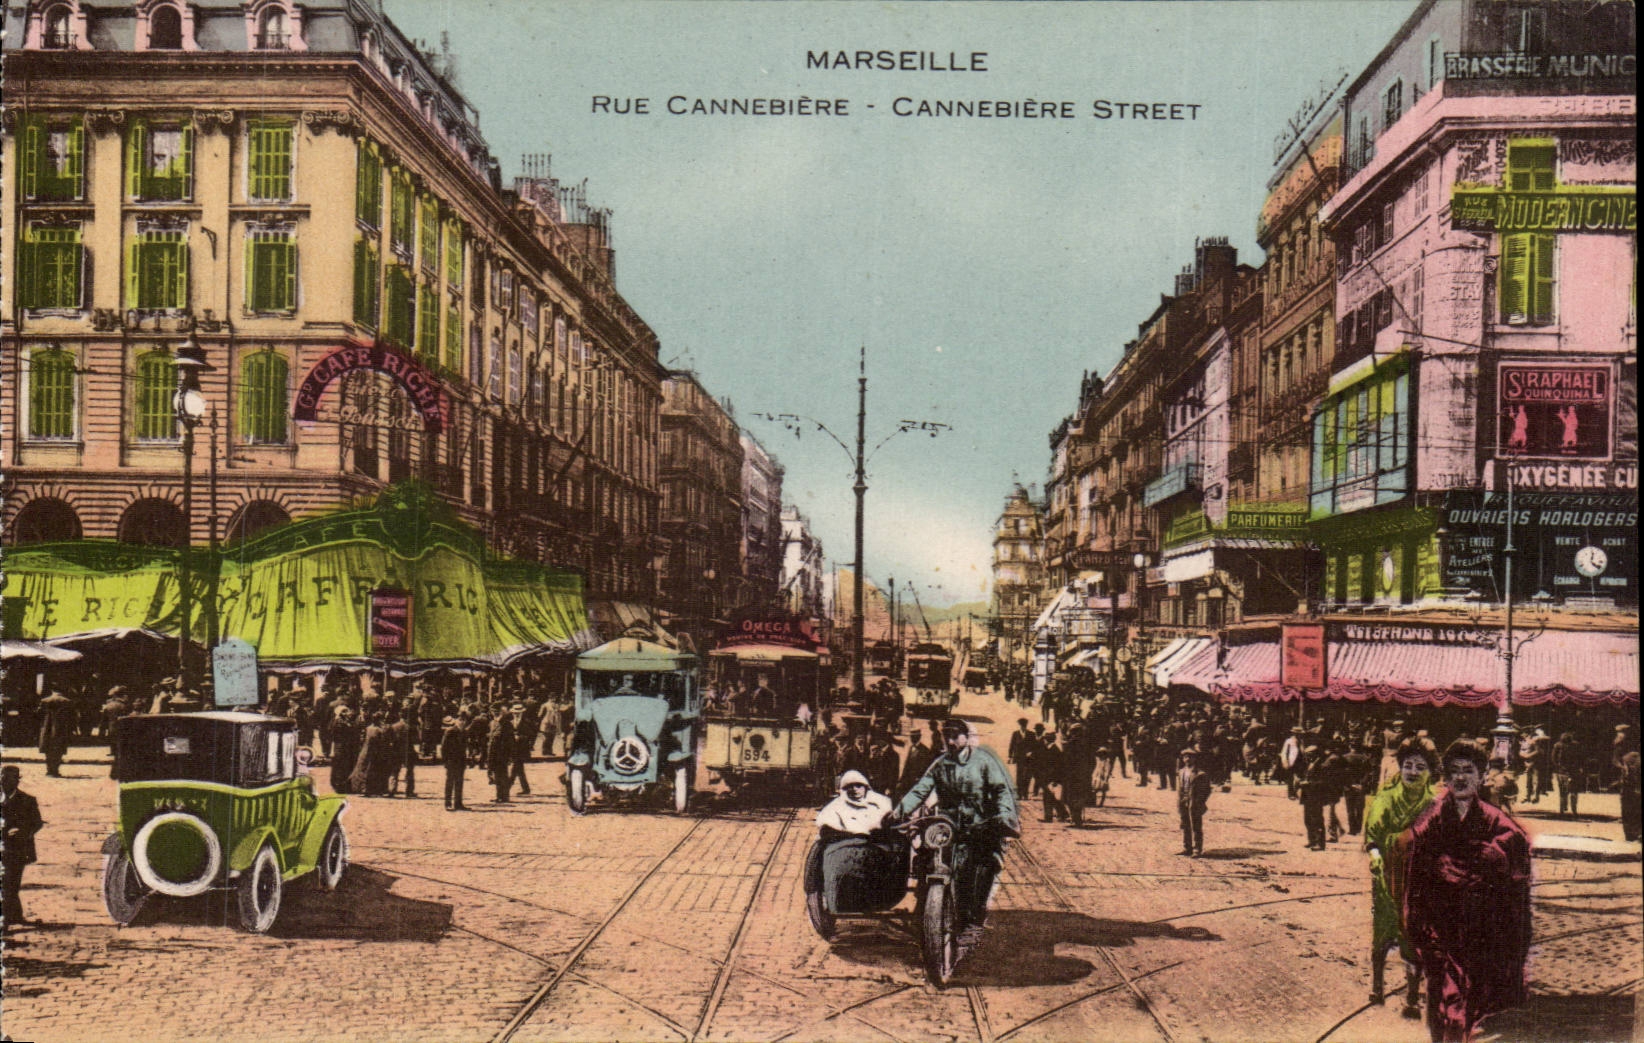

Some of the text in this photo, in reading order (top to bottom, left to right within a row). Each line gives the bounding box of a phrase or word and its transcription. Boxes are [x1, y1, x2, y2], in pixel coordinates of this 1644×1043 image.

[1446, 52, 1542, 79] BRASSERIE
[383, 352, 441, 418] RICHE
[1231, 513, 1303, 528] PARFUMERIE
[1538, 511, 1638, 527] HORLOGERS
[1555, 536, 1580, 546] VENTE
[742, 619, 792, 633] OMEGA
